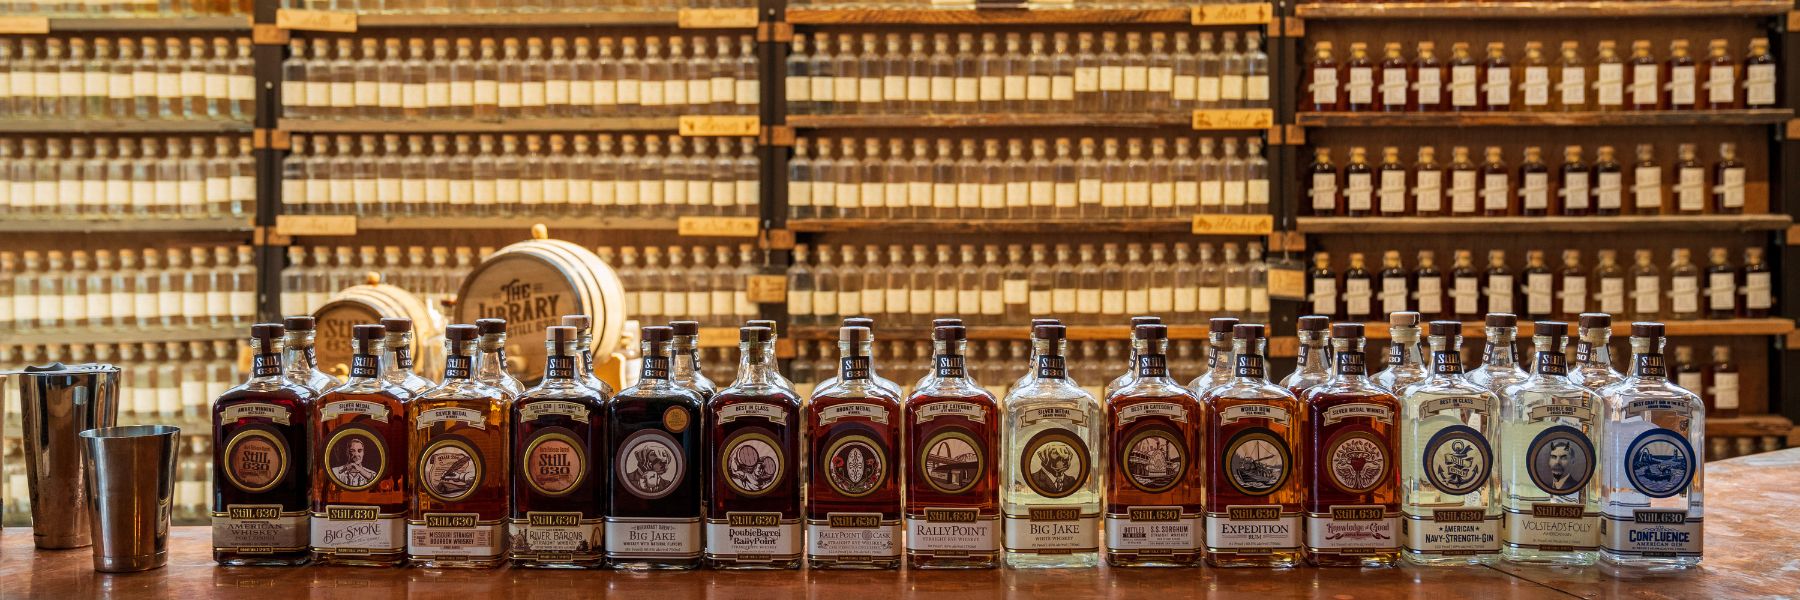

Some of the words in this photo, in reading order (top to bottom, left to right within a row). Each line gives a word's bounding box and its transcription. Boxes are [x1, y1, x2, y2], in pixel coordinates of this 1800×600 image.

[502, 278, 531, 304] THE
[242, 462, 270, 470] 630
[540, 467, 570, 475] 630
[256, 509, 276, 518] 630
[354, 510, 374, 520] 630
[953, 512, 974, 521] 630
[1056, 510, 1076, 520] 630
[1156, 511, 1177, 520] 630
[1256, 510, 1276, 519] 630
[1359, 510, 1380, 519] 630
[1461, 512, 1480, 521] 630
[1559, 507, 1580, 517] 630
[453, 517, 473, 527] 630
[556, 516, 576, 526] 630
[756, 516, 776, 526] 630
[856, 517, 878, 526] 630
[1662, 513, 1682, 523] 630
[323, 529, 343, 544] BIG
[345, 523, 381, 541] SMOKE
[917, 525, 987, 536] RALLYPOINT
[1030, 524, 1050, 534] BIG
[1052, 524, 1080, 536] JAKE
[1222, 524, 1288, 534] EXPEDITION
[1444, 525, 1474, 533] AMERICAN
[529, 531, 552, 540] RIVER
[554, 531, 583, 540] BARONS
[629, 531, 648, 540] BIG
[651, 531, 676, 541] JAKE
[819, 531, 861, 539] RALLYPOINT
[1629, 530, 1690, 542] CONFLUENCE
